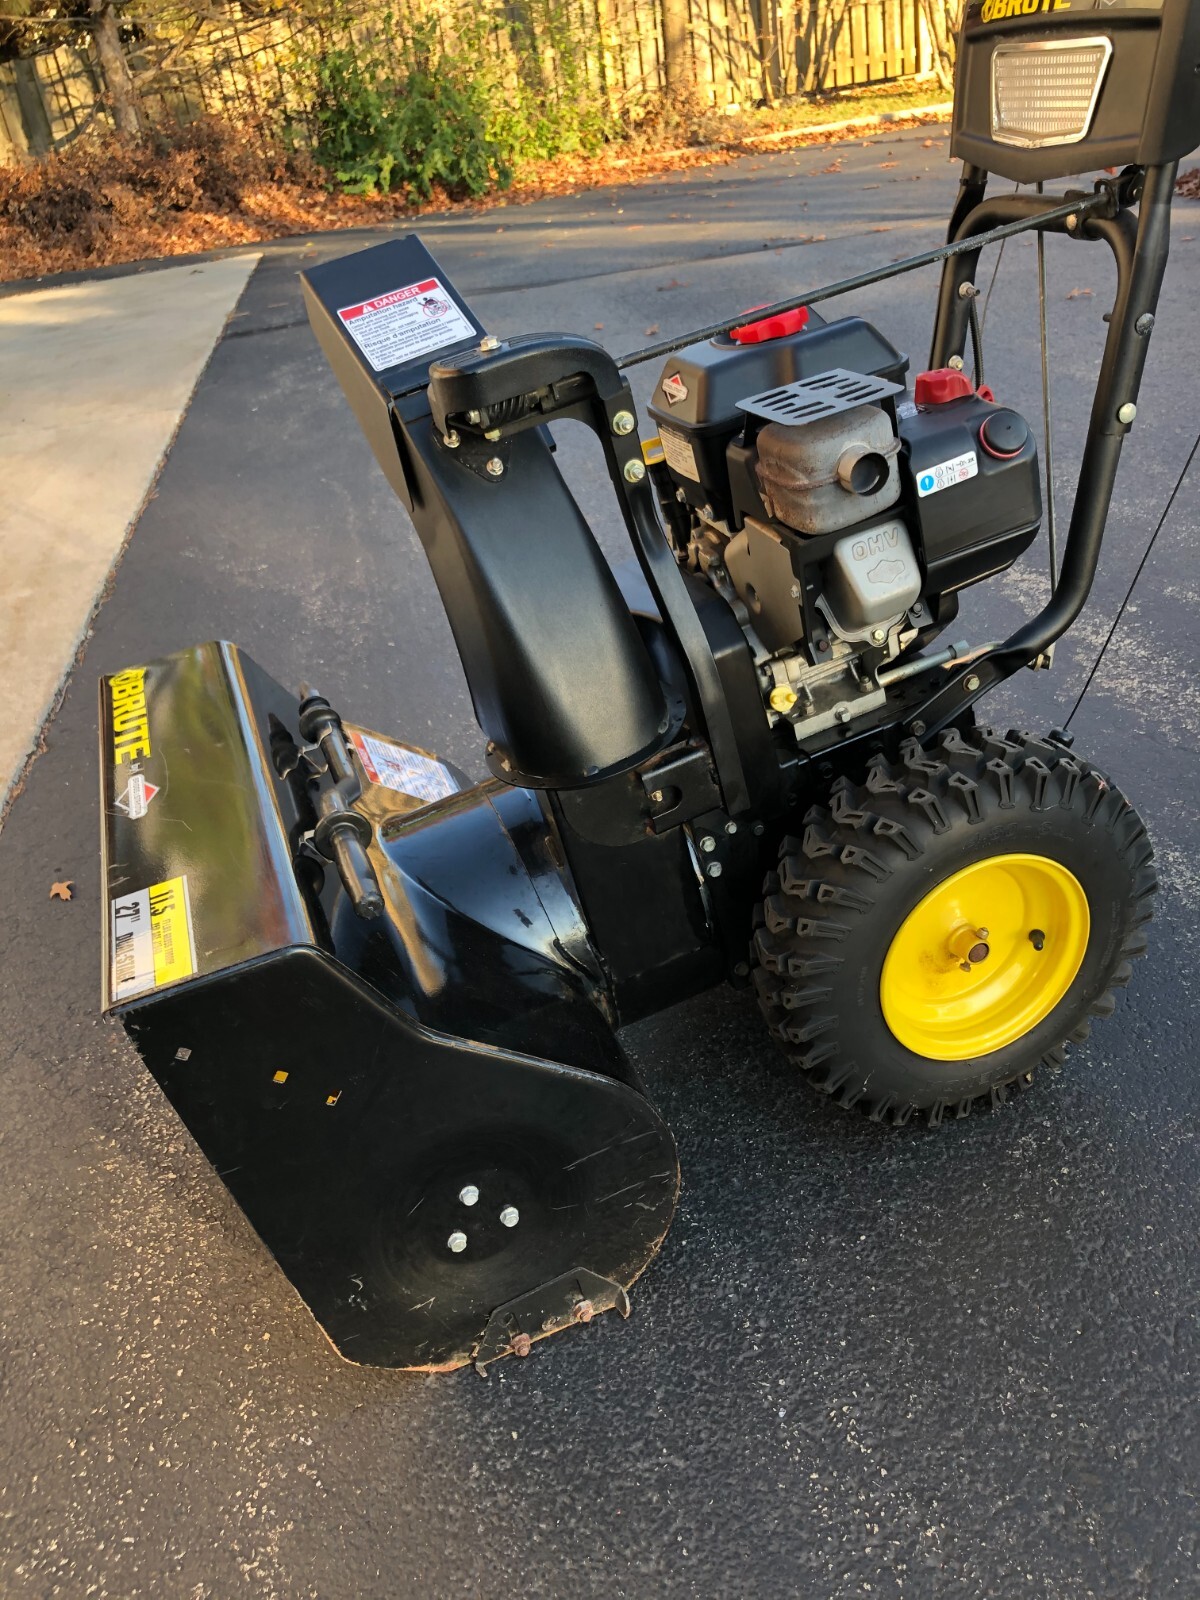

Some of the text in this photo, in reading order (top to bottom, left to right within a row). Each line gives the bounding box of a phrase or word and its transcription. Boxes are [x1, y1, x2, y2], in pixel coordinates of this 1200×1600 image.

[347, 306, 392, 325] Amputation
[391, 297, 418, 309] hazard
[372, 286, 421, 307] DANGER
[363, 335, 391, 349] Risque
[391, 317, 441, 338] d'amputation
[852, 527, 898, 561] OHV
[111, 678, 151, 764] BRUTE
[115, 901, 140, 923] 27"
[150, 889, 175, 917] 11.5
[116, 931, 135, 984] DUAL-STAGE
